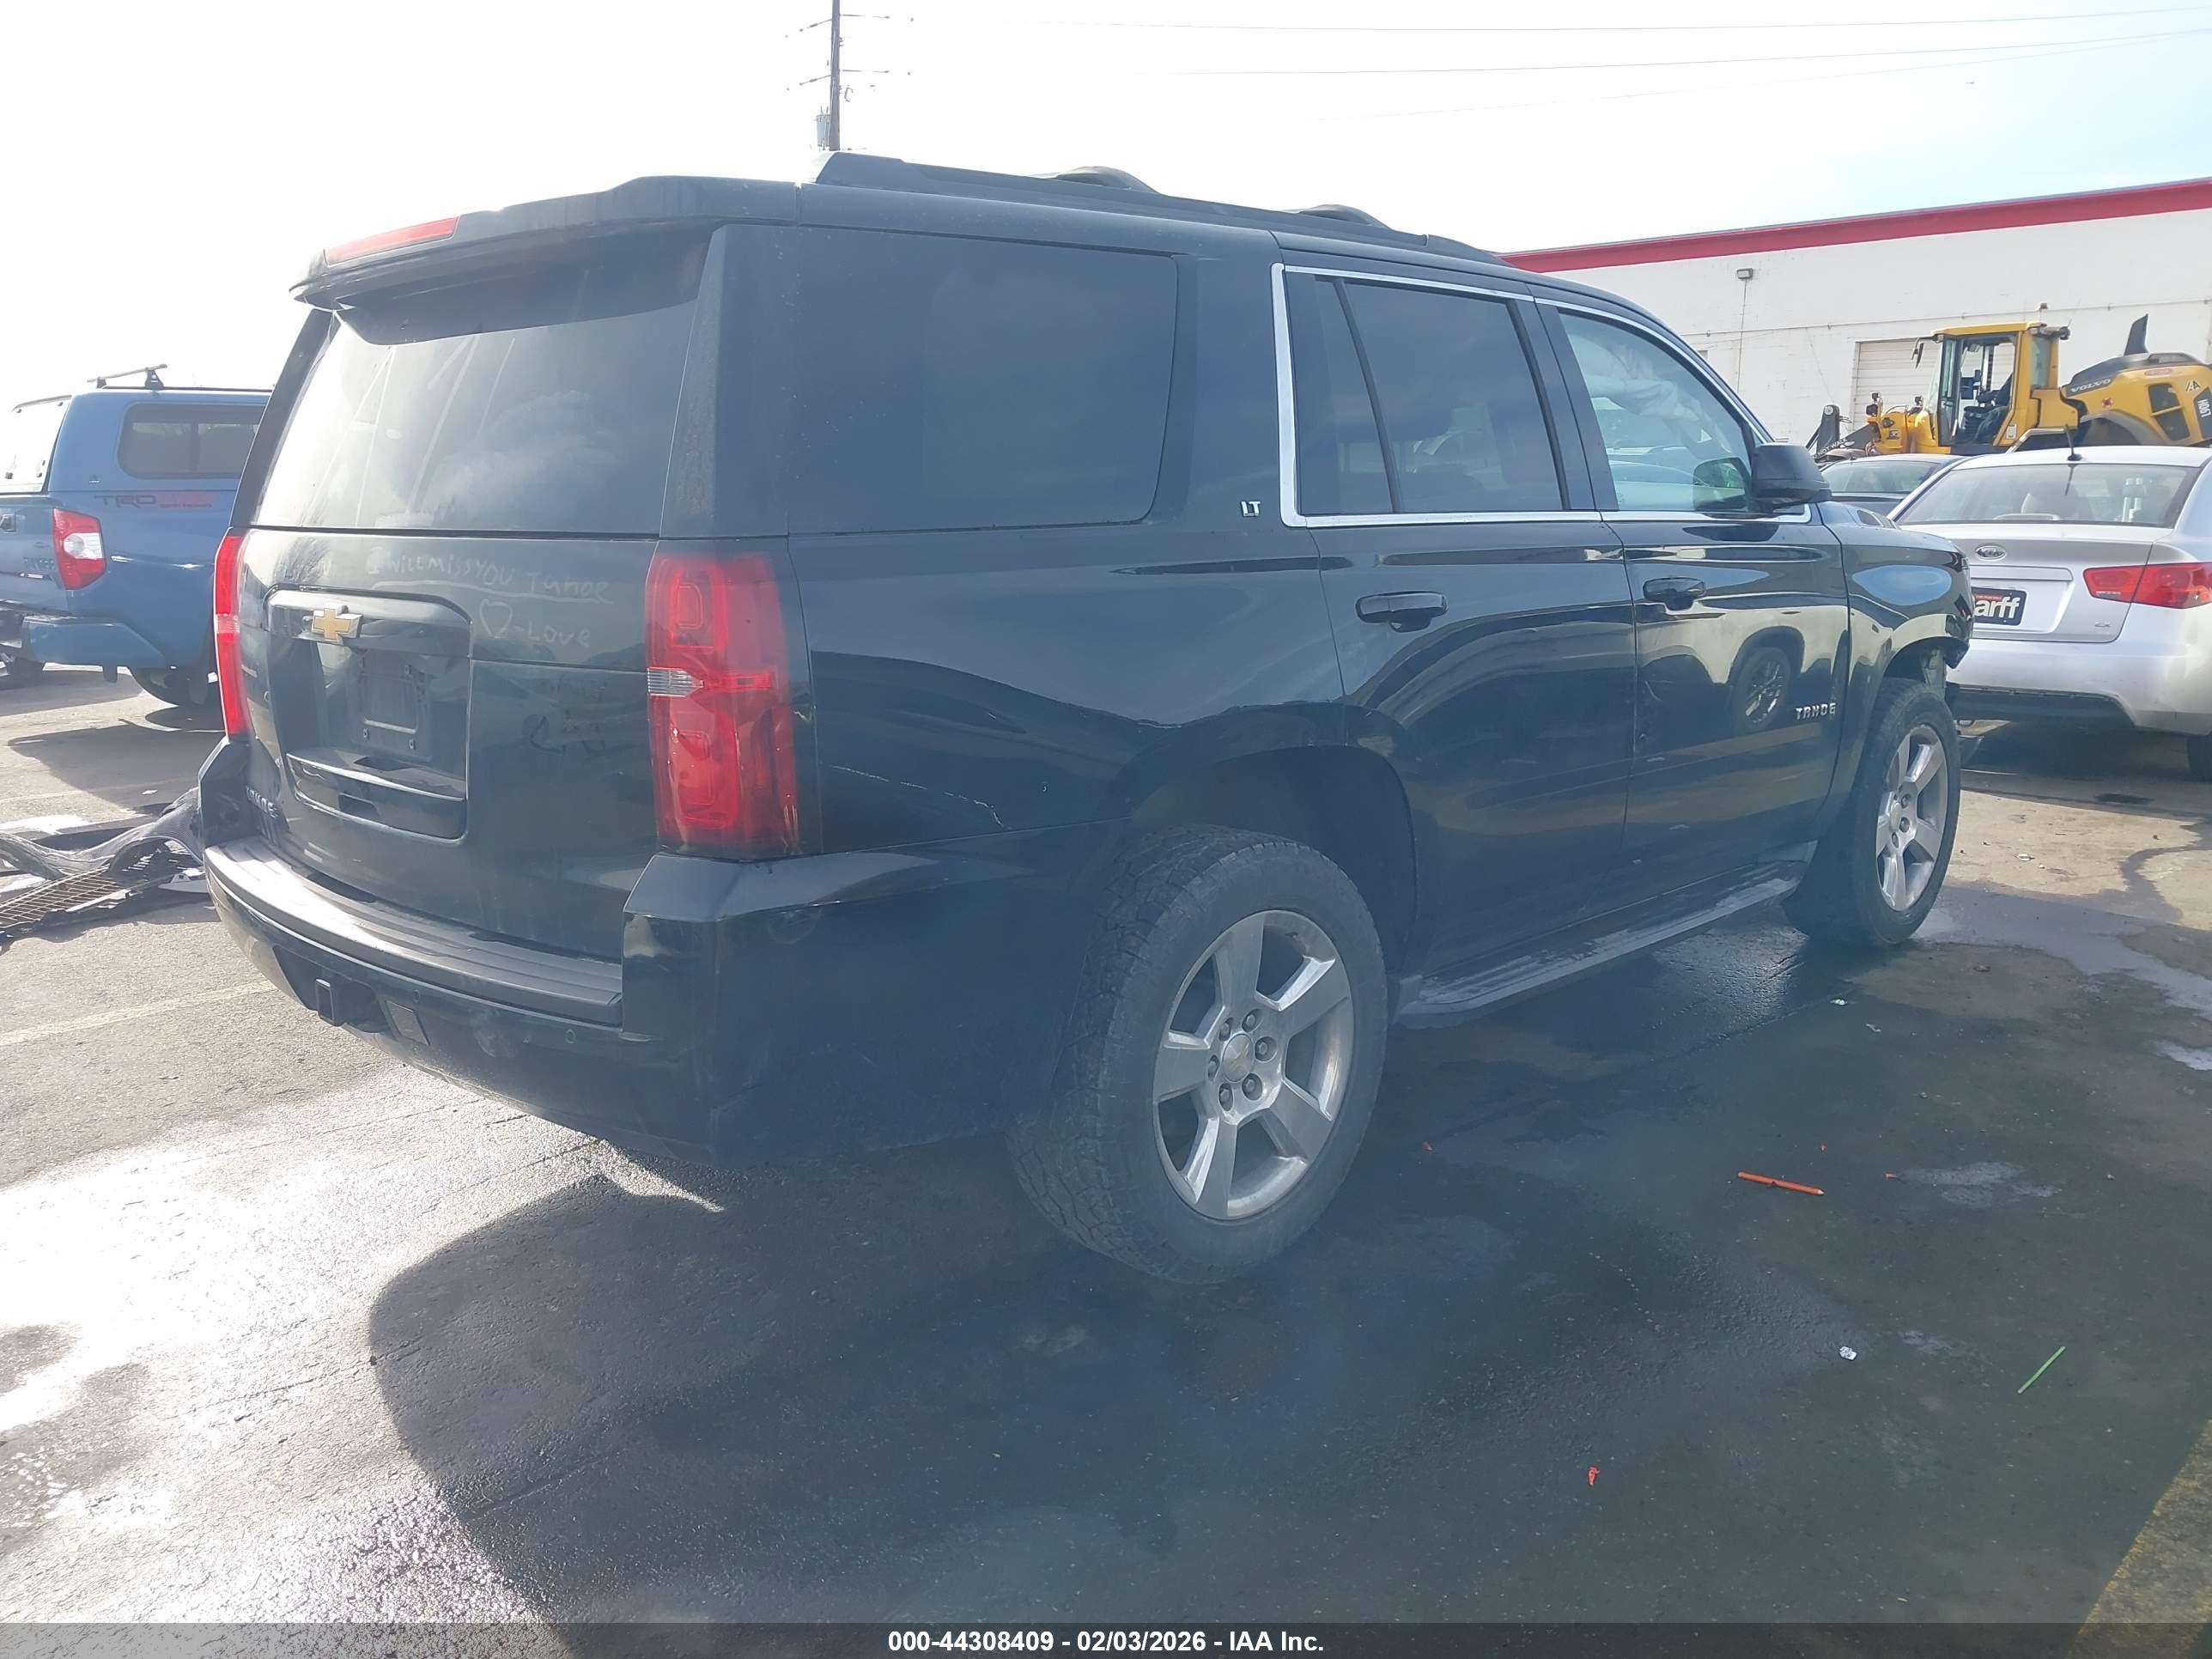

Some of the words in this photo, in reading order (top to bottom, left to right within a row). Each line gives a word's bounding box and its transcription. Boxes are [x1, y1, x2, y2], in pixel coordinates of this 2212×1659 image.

[2070, 378, 2112, 393] VOLVO
[94, 495, 156, 508] TRD
[1241, 501, 1261, 516] LT
[1972, 595, 2021, 618] arff
[1796, 702, 1837, 720] TAHOE
